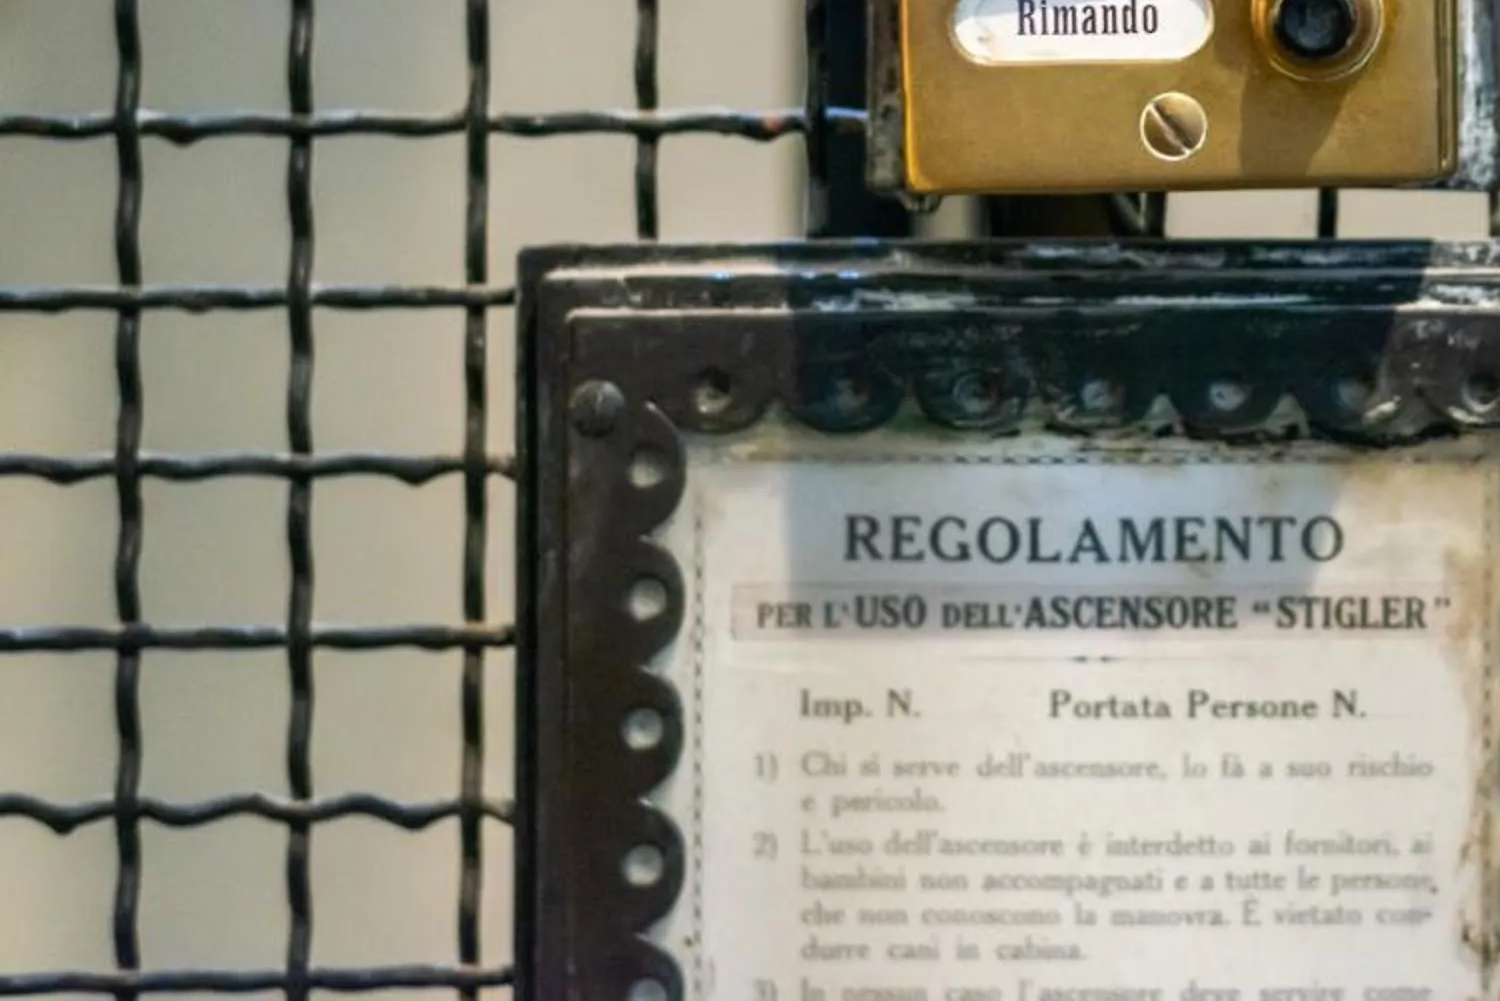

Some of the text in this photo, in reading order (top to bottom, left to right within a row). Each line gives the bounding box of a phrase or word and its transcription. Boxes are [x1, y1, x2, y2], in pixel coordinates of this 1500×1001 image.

[844, 514, 1344, 563] REGOLAMENTO
[756, 601, 812, 629] PER
[800, 689, 1366, 723] Imp. N. Portata Persone N.
[755, 753, 778, 783] 1)
[801, 752, 847, 776] Chi
[860, 752, 880, 776] si
[893, 759, 960, 777] serve
[1183, 752, 1207, 778] lo
[1258, 761, 1273, 778] a
[1286, 761, 1331, 778] suo
[1348, 751, 1433, 778] rischio
[801, 788, 945, 817] e pericolo.
[753, 831, 778, 860] 2)
[801, 830, 873, 855] L'uso
[1105, 831, 1234, 856] interdetto
[1248, 833, 1270, 855] ai
[801, 865, 905, 890] bambini
[920, 874, 968, 890] non
[982, 867, 1163, 897] accompagnati
[1174, 874, 1188, 891] e
[1200, 874, 1214, 891] a
[1225, 870, 1286, 891] tutte
[1298, 866, 1319, 891] le
[801, 901, 845, 925] che
[858, 908, 908, 925] non
[921, 908, 1060, 925] conoscono
[1075, 901, 1097, 925] la
[1273, 903, 1363, 926] vietato
[801, 936, 870, 960] durre
[886, 938, 940, 960] cani
[955, 937, 980, 960] in
